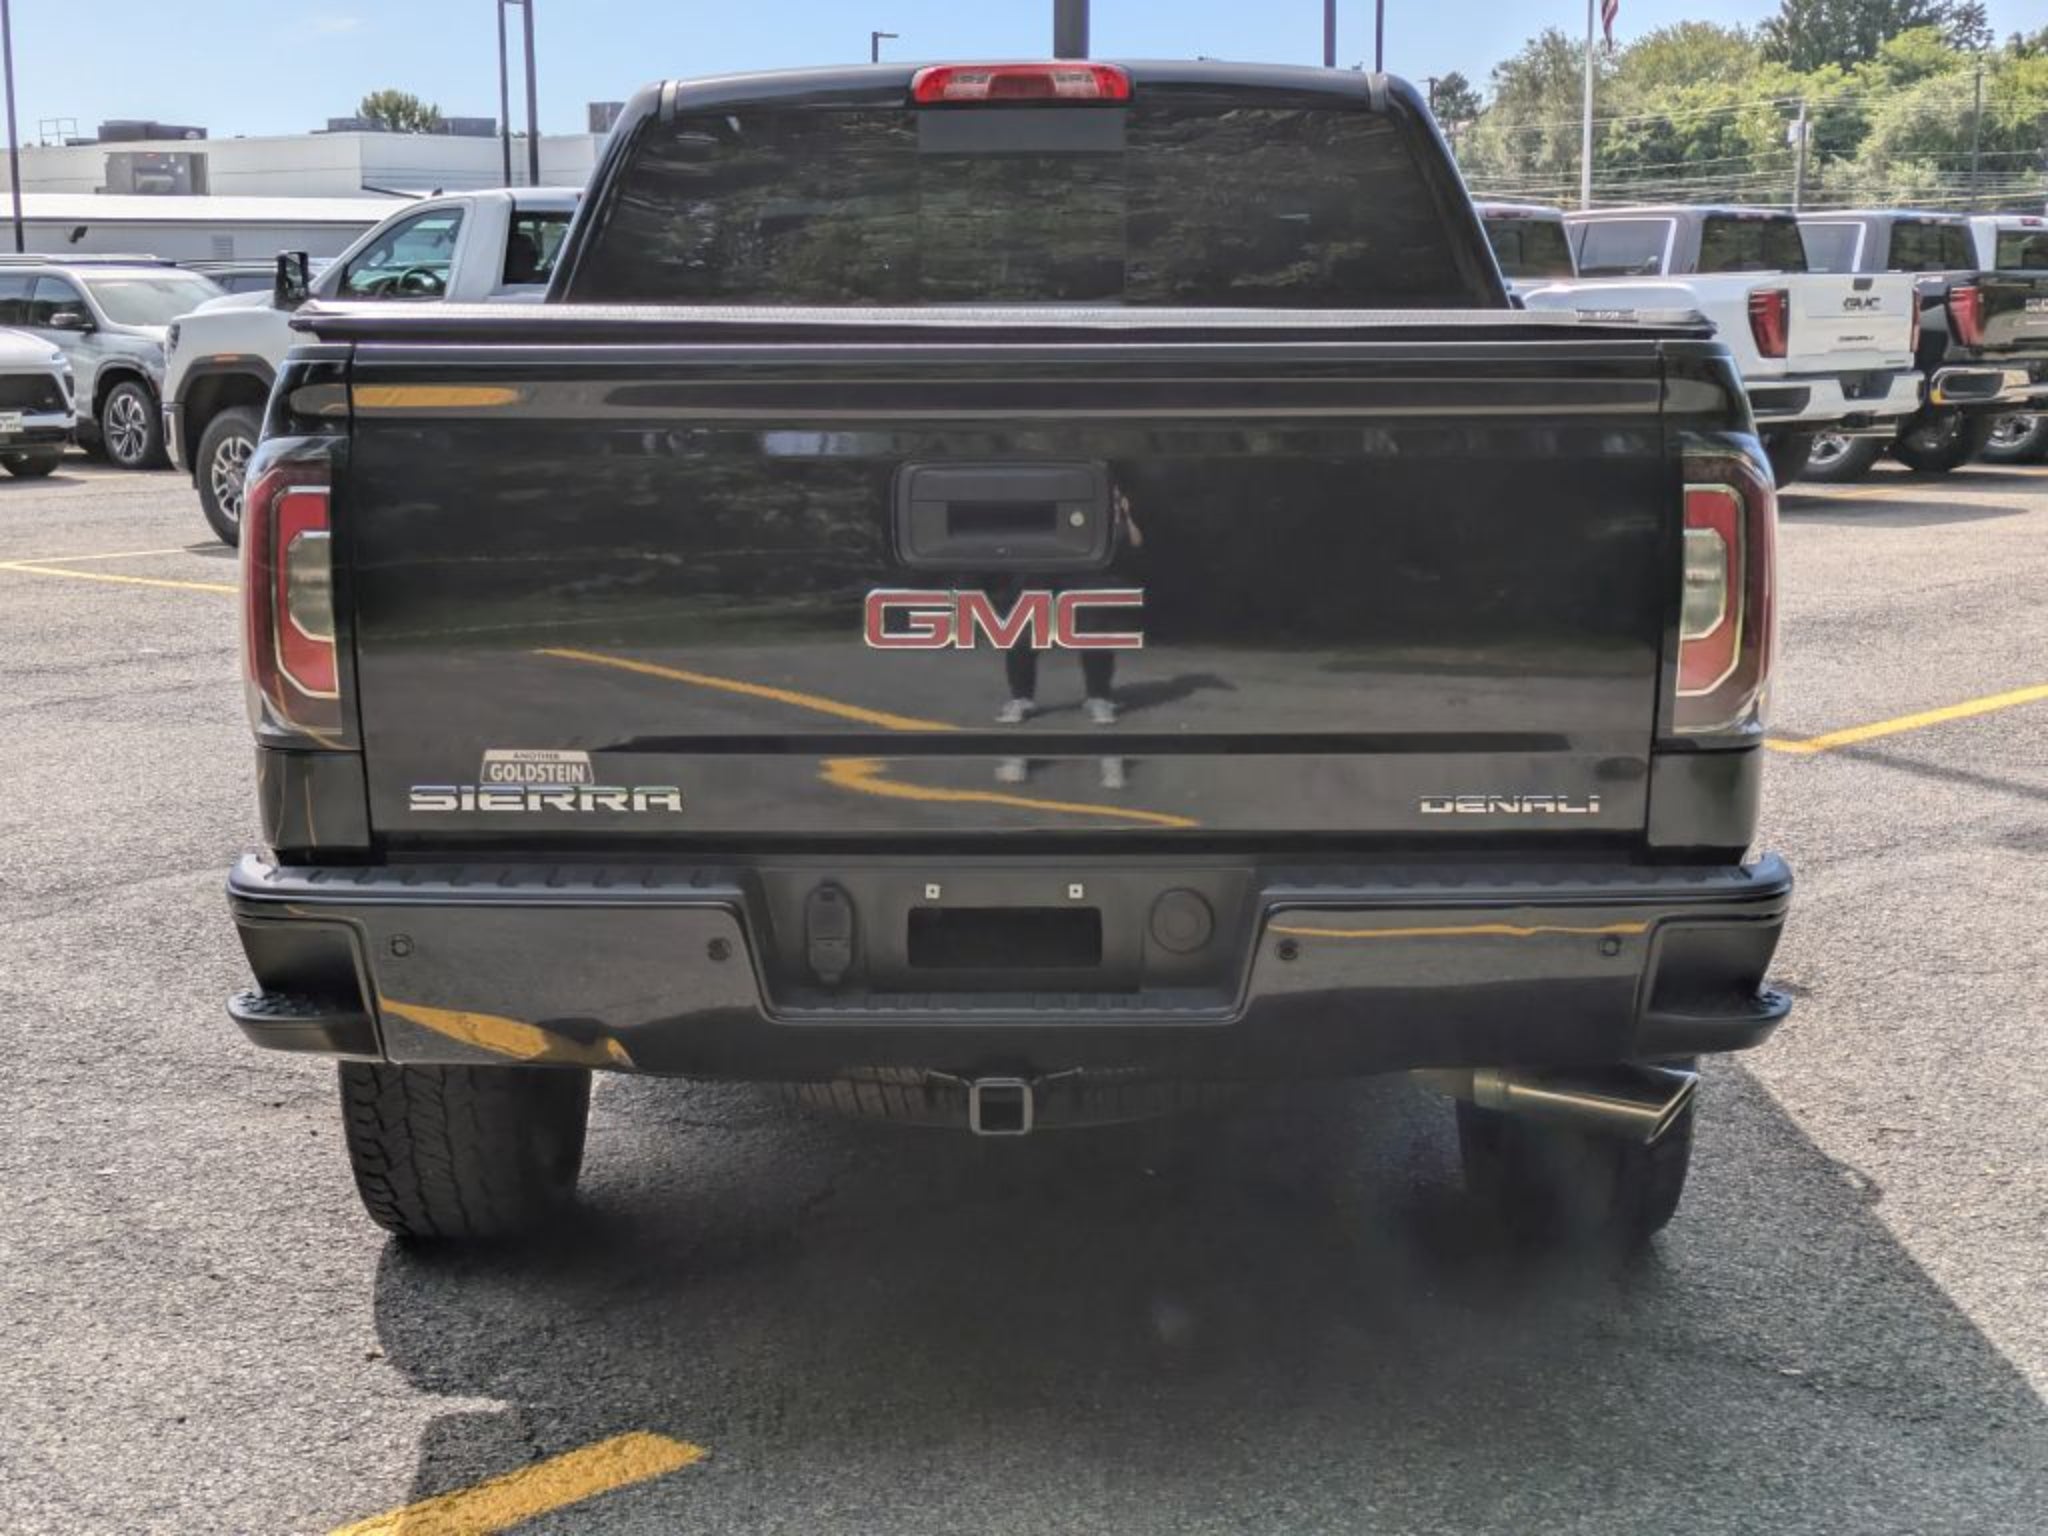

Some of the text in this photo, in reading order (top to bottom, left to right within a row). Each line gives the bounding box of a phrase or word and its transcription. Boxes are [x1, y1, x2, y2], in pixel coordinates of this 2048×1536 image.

[864, 588, 1144, 649] GMC
[513, 751, 560, 760] ANOTHER
[490, 763, 585, 782] GOLDSTEIN
[409, 785, 683, 811] SIERRA
[1420, 795, 1600, 813] DENALI
